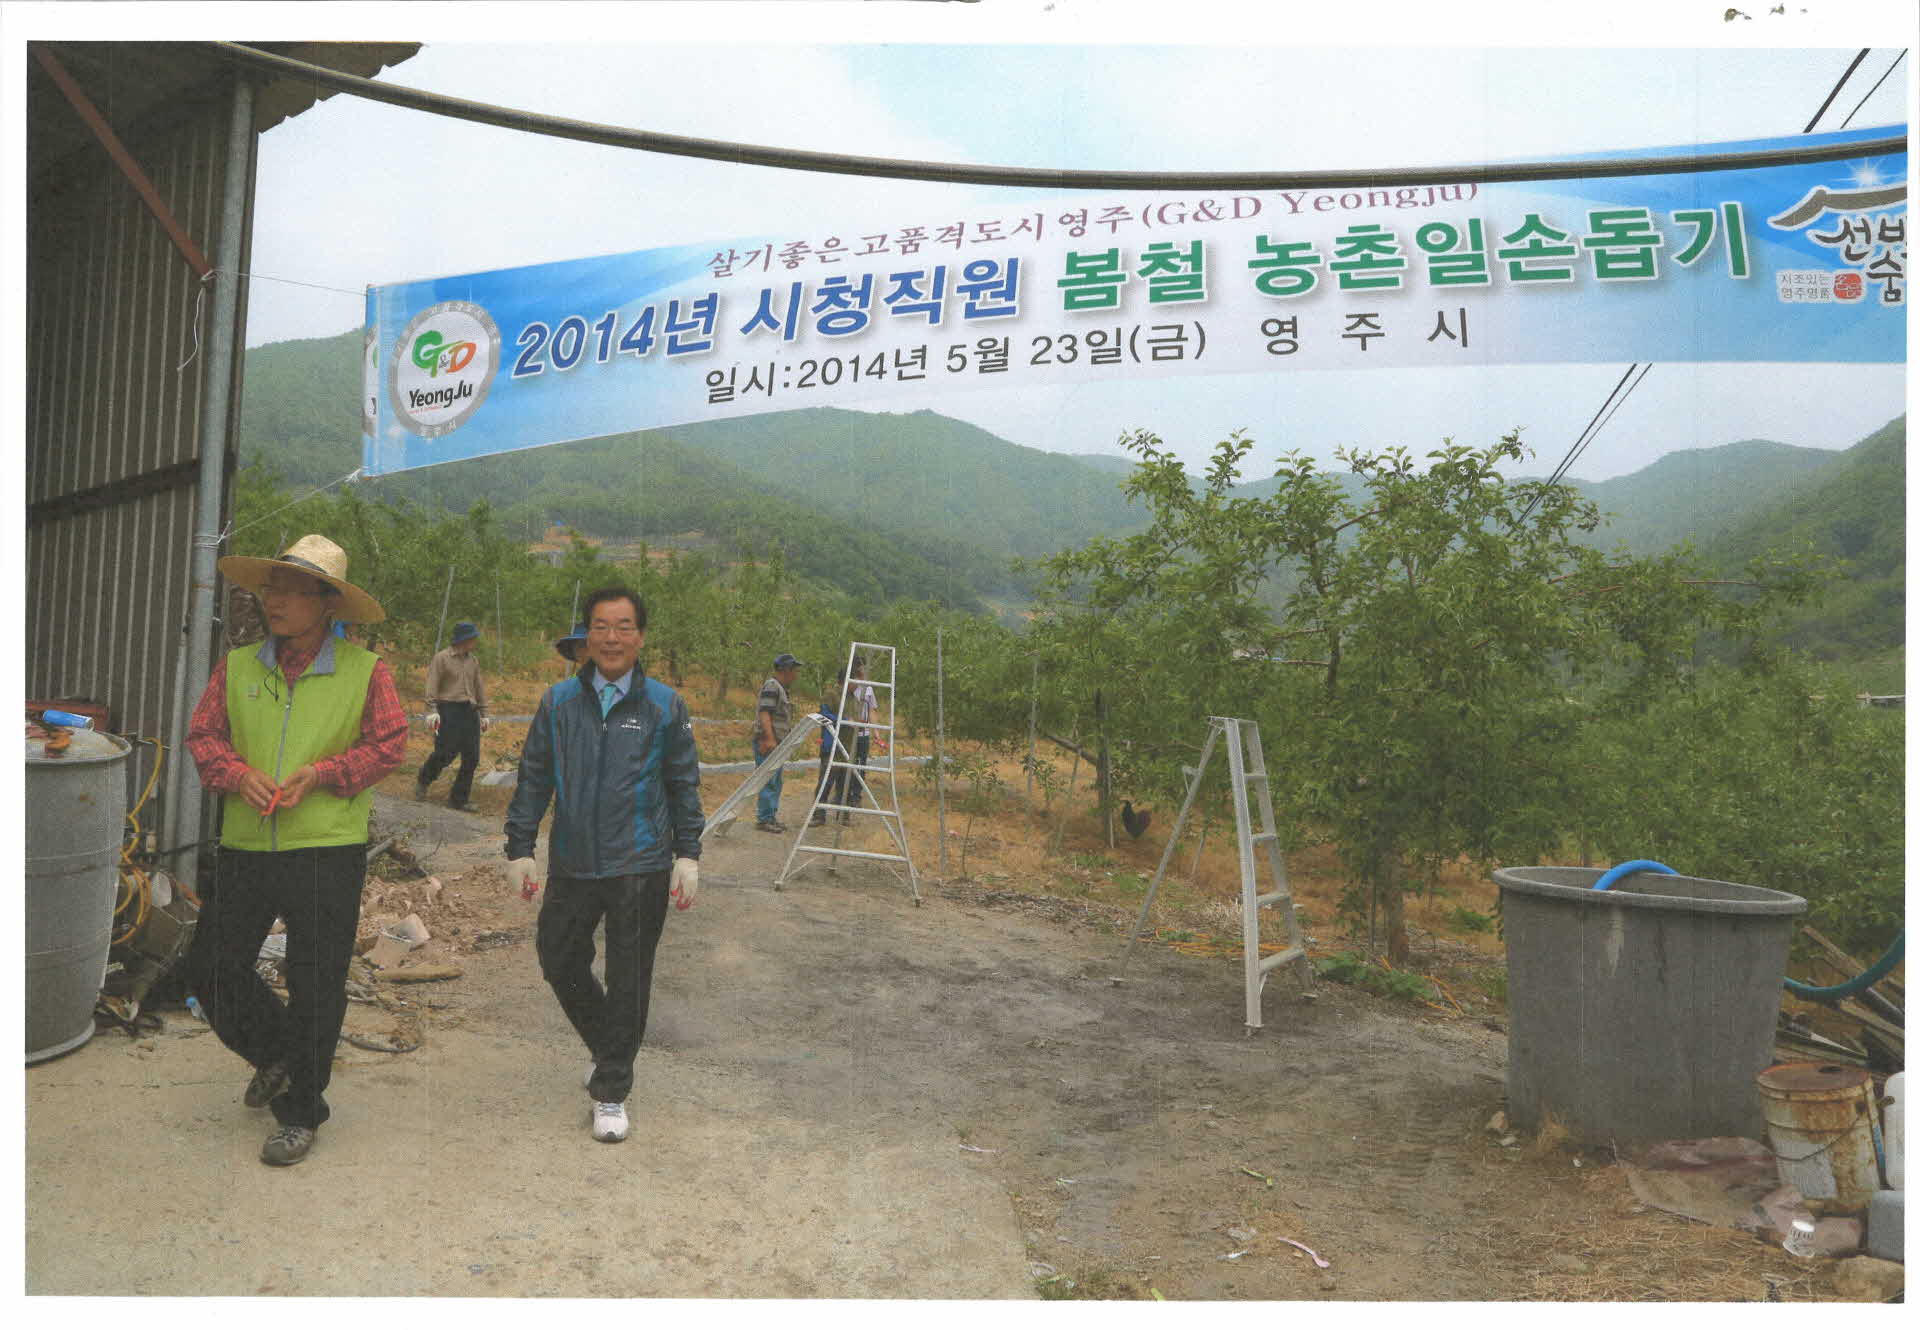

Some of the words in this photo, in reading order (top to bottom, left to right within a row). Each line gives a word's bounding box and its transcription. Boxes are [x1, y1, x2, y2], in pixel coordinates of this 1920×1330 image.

[1280, 183, 1479, 215] Yeongju)
[514, 293, 720, 377] 2014년
[740, 257, 1020, 342] 시청직원
[1058, 240, 1205, 311] 봄철
[1247, 203, 1747, 297] 농촌일손돕기
[947, 337, 1011, 375] 5월
[1030, 322, 1208, 367] 23일(금)
